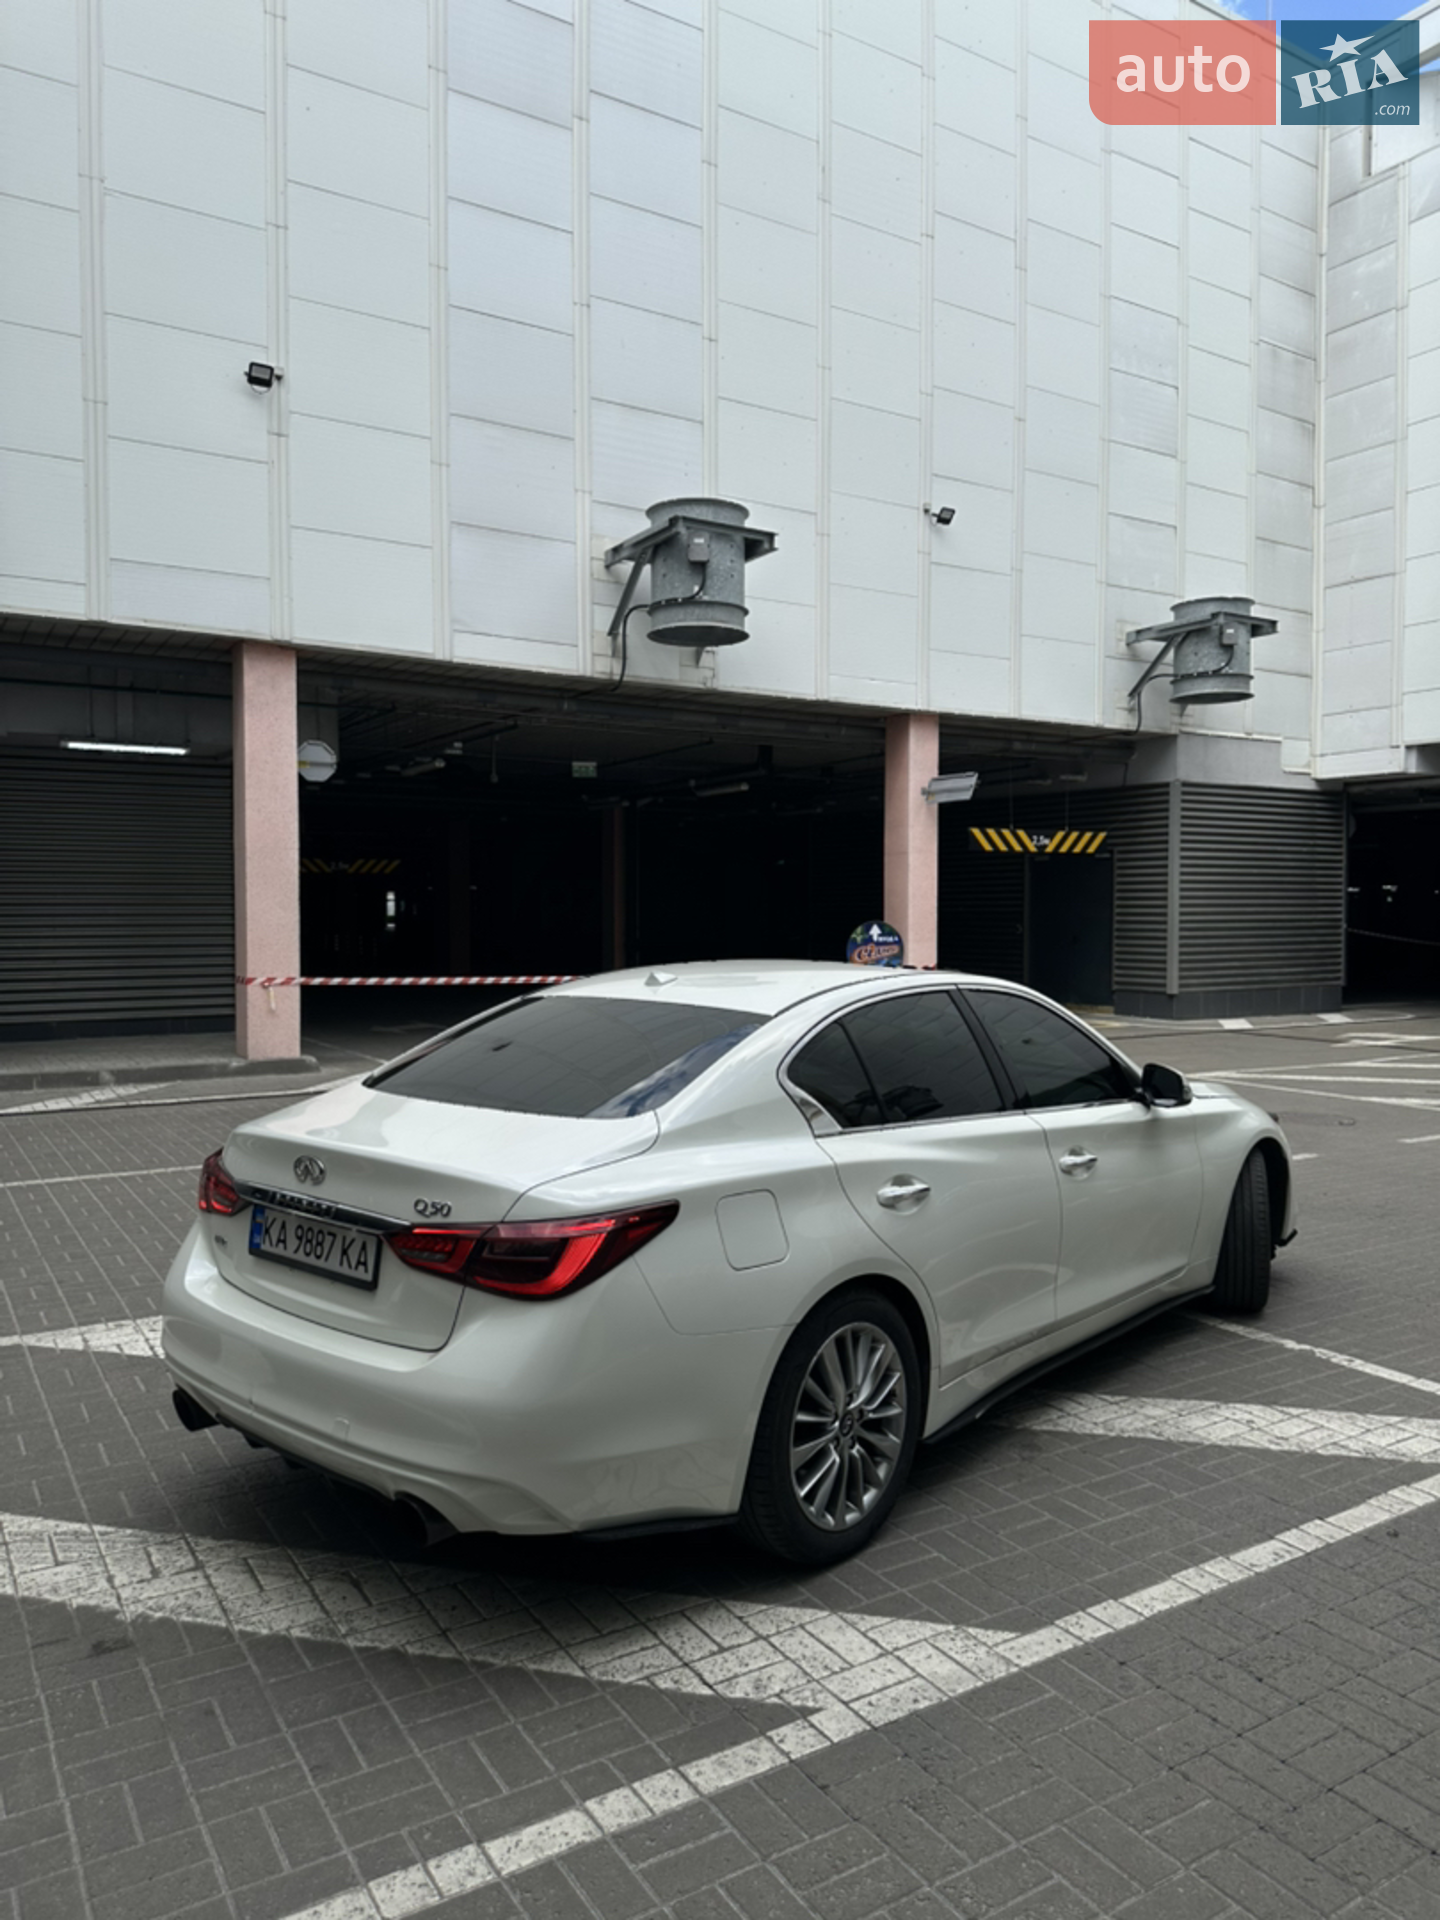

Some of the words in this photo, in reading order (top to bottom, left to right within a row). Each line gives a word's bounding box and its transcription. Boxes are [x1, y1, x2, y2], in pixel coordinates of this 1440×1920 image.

[413, 1197, 453, 1219] Q50
[262, 1216, 288, 1251] KA
[293, 1224, 337, 1262] 9887
[339, 1235, 369, 1273] KA
